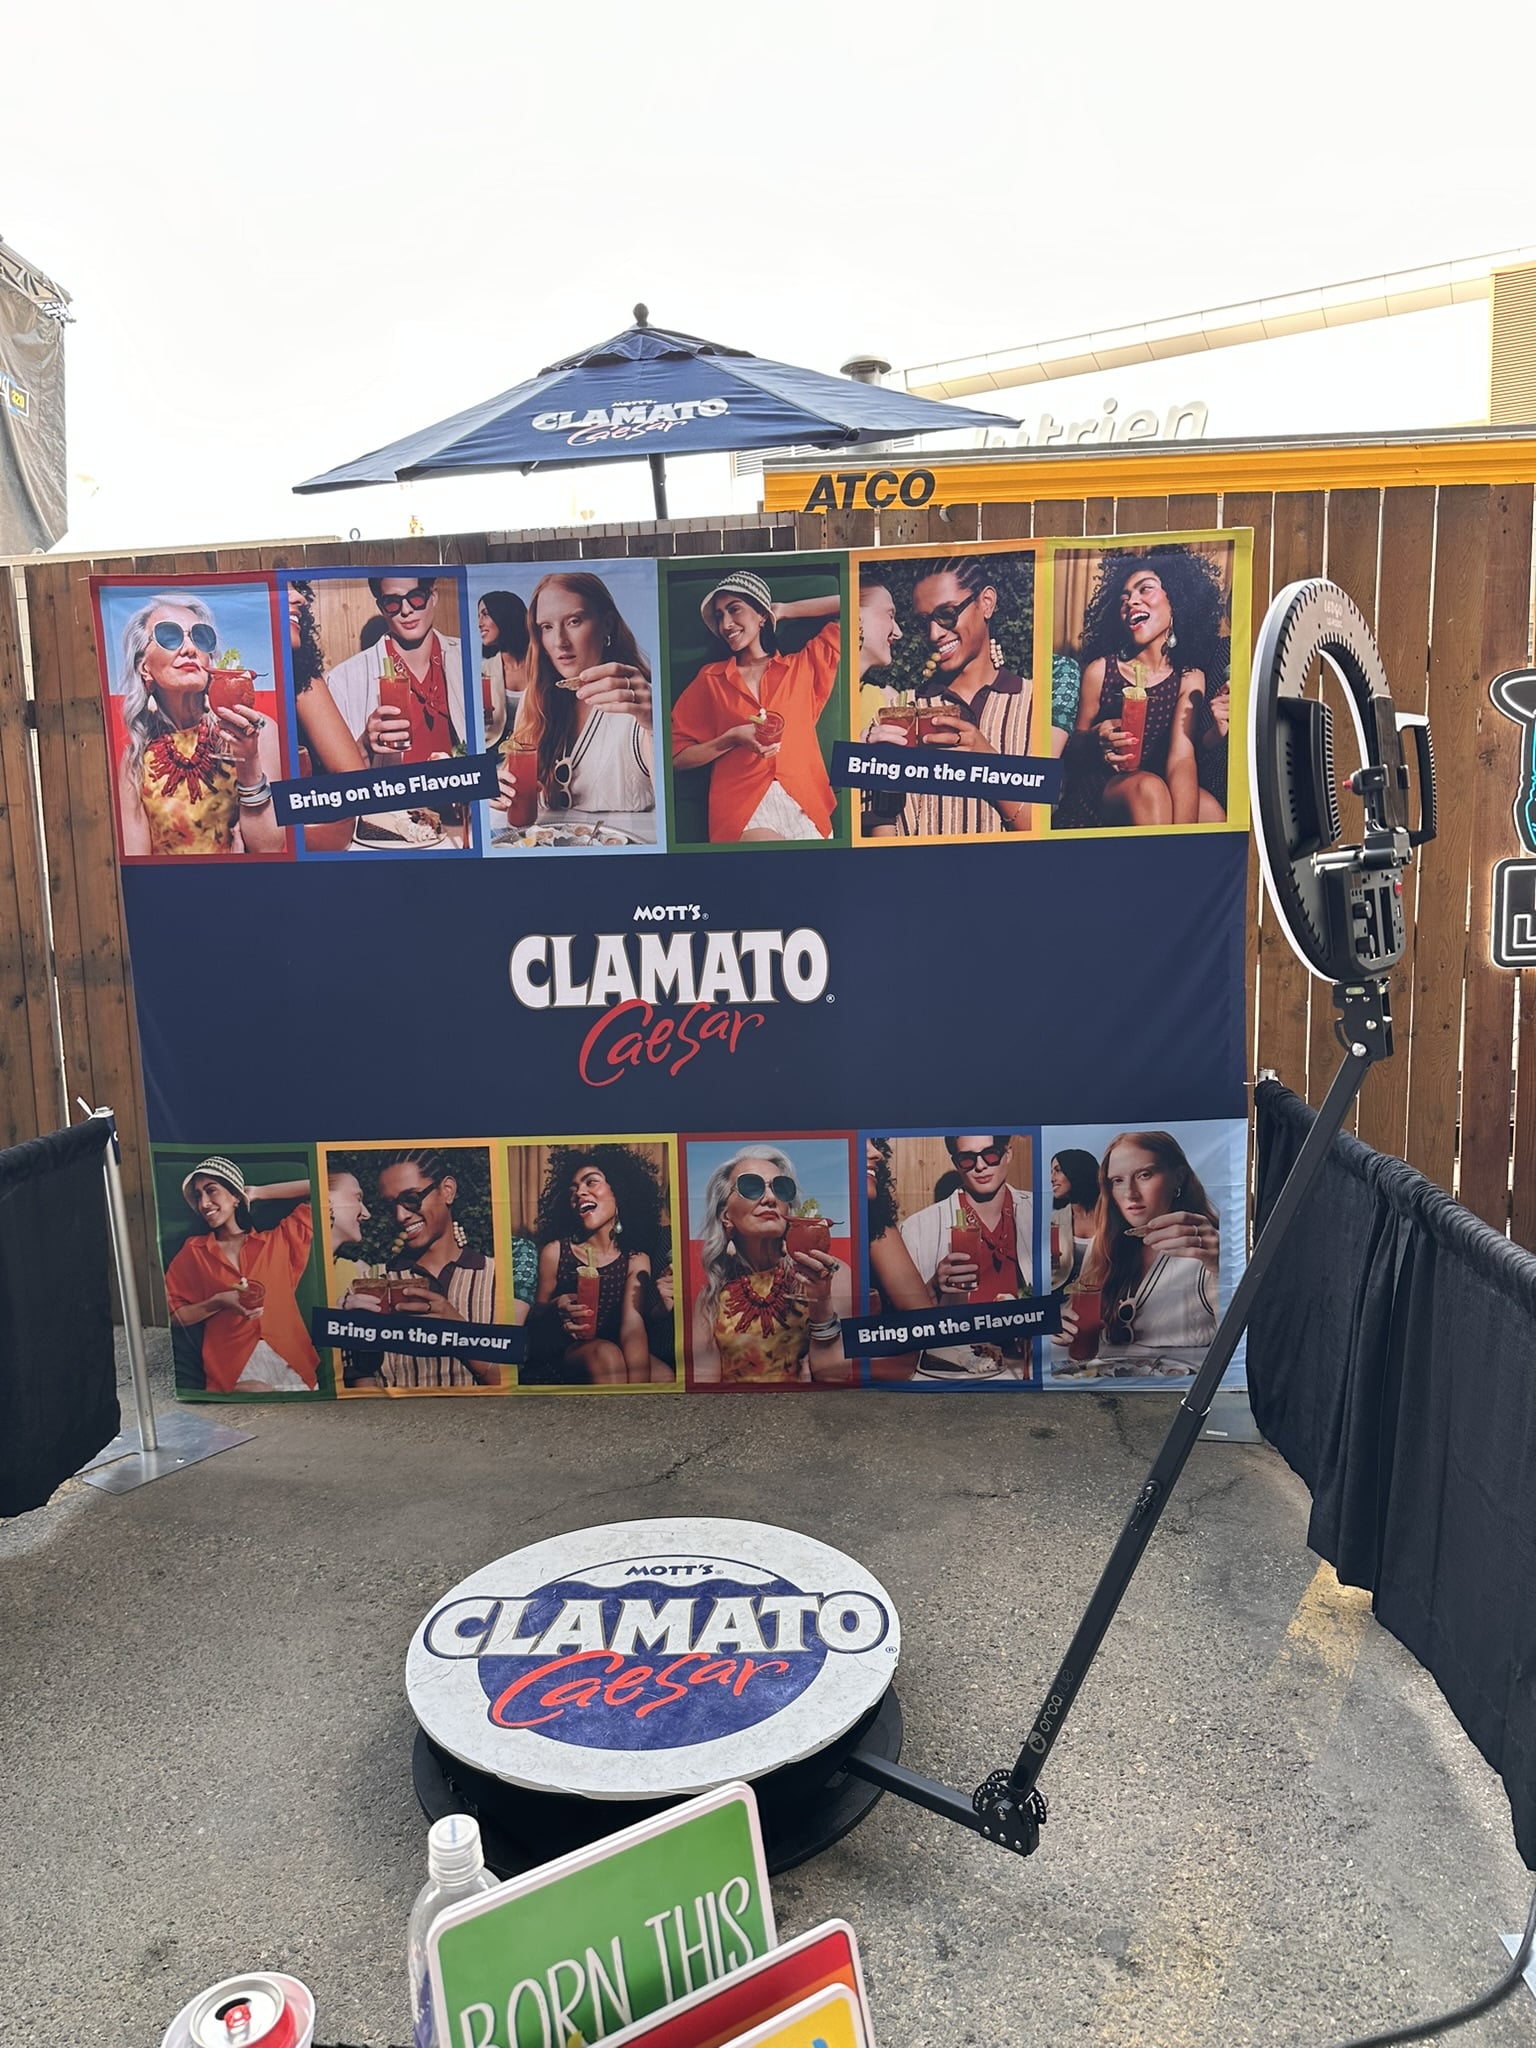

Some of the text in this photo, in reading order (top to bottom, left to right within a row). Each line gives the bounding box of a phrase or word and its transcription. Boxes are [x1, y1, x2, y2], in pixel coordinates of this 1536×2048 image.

[532, 398, 729, 431] CLAMATO
[567, 420, 688, 446] Caesar
[803, 469, 936, 512] ATCO
[848, 756, 1045, 787] Bring on the Flavour
[289, 770, 482, 810] Bring on the Flavour
[633, 904, 701, 921] MOTT'S
[509, 927, 829, 1010] CLAMATO
[579, 998, 765, 1087] Caesar
[327, 1321, 511, 1350] Bring on the Flavour
[858, 1310, 1045, 1343] Bring on the Flavour
[624, 1564, 715, 1576] MOTT'S
[425, 1592, 888, 1658] CLAMATO
[492, 1649, 788, 1728] Caesar
[460, 1876, 754, 2048] BORN THIS
